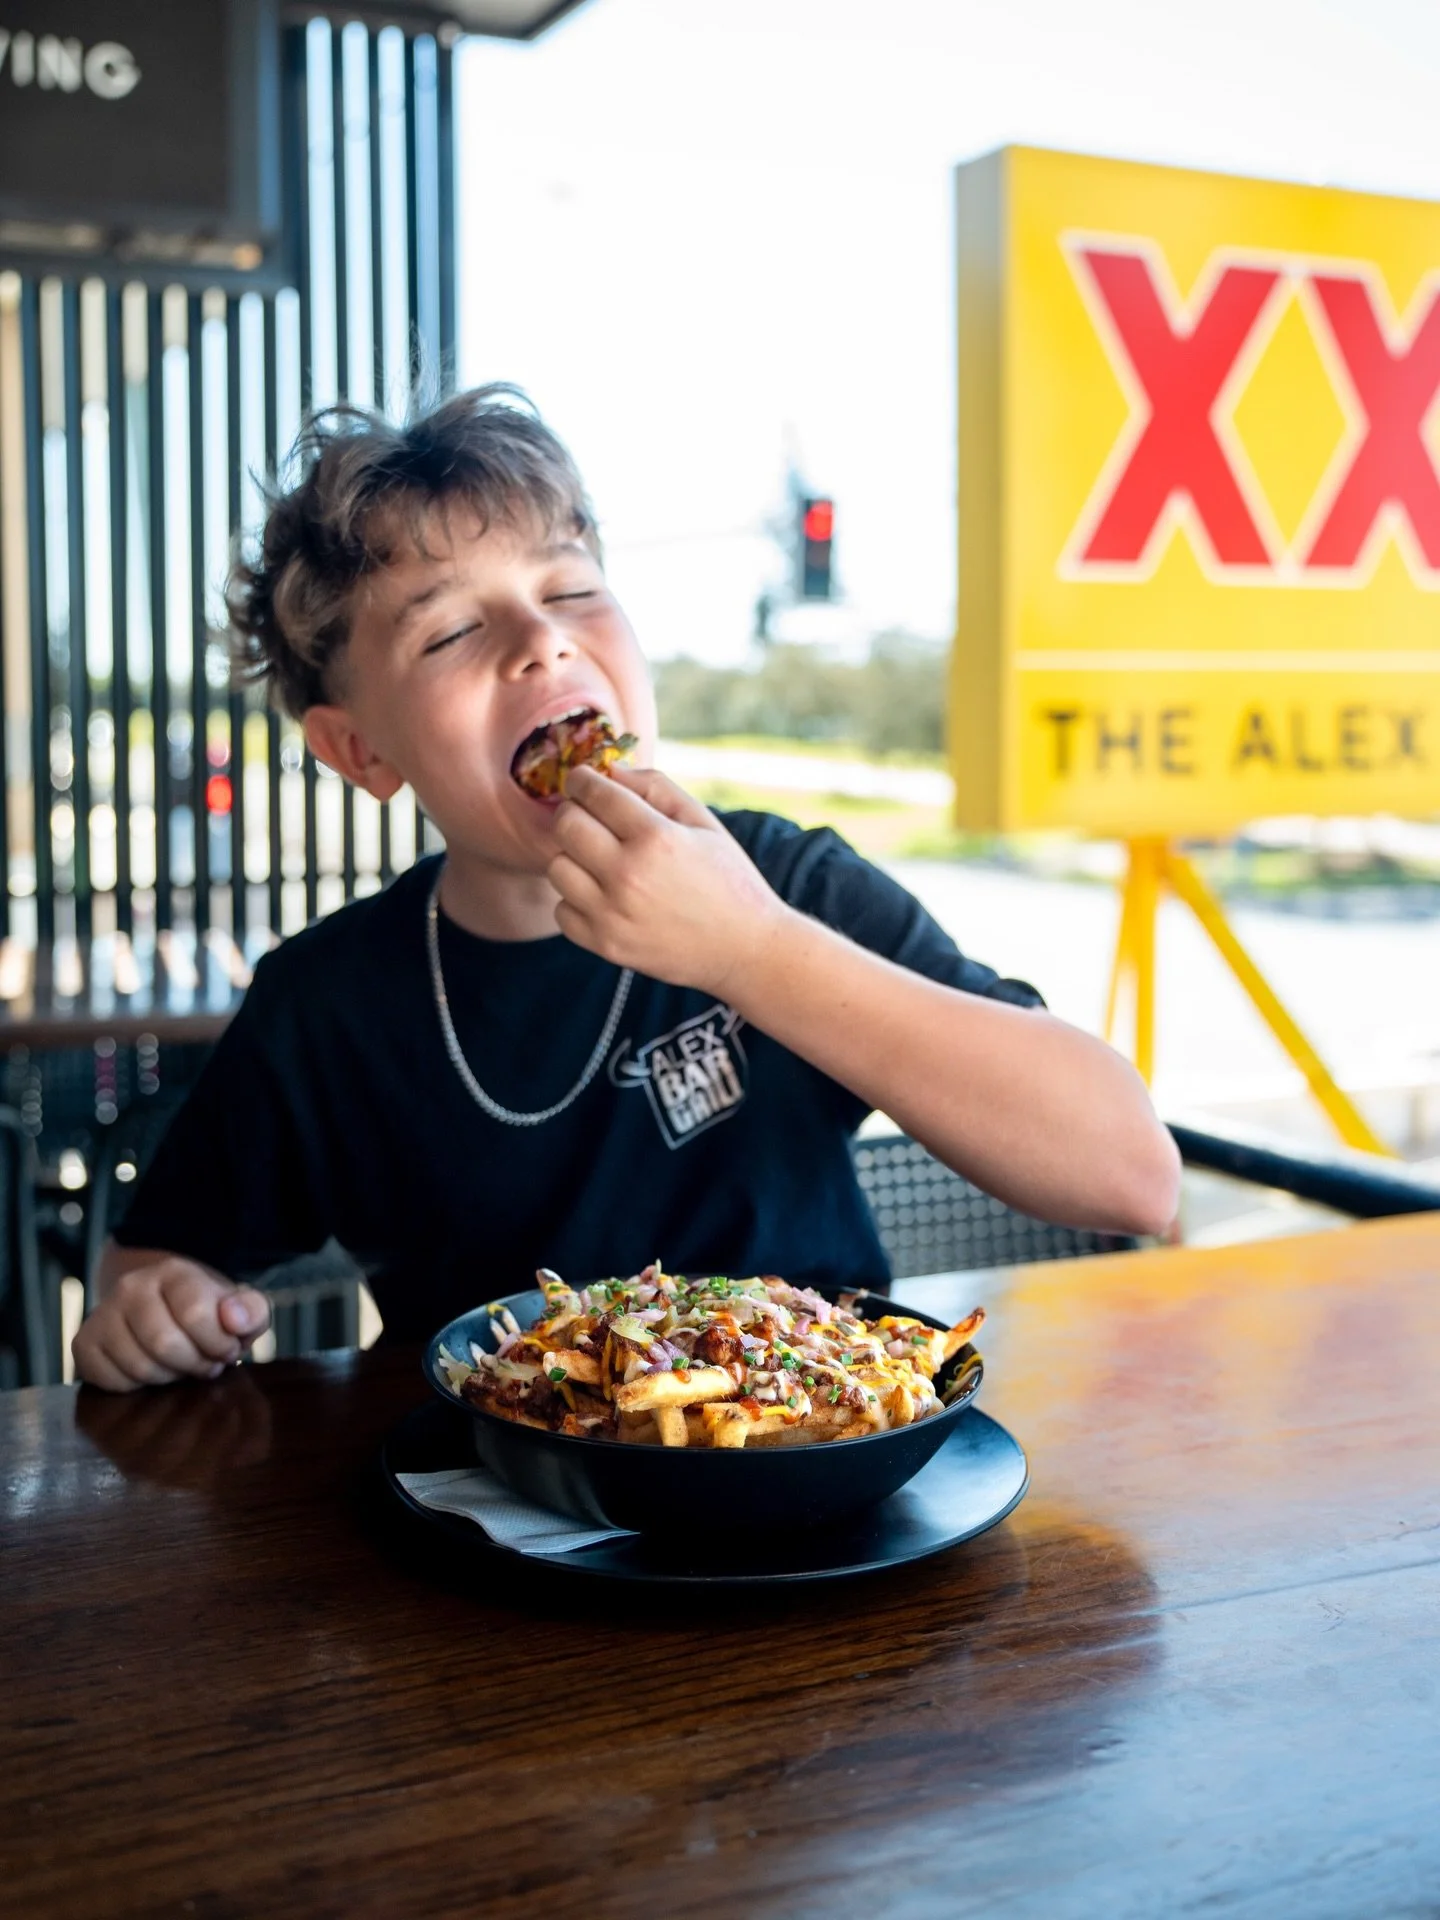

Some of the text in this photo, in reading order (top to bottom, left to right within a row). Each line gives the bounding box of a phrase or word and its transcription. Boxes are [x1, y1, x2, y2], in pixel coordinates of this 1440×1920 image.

[1056, 228, 1440, 592] XX
[1045, 703, 1426, 779] THE ALEX
[653, 1022, 724, 1080] ALEX
[657, 1047, 735, 1108] BAR
